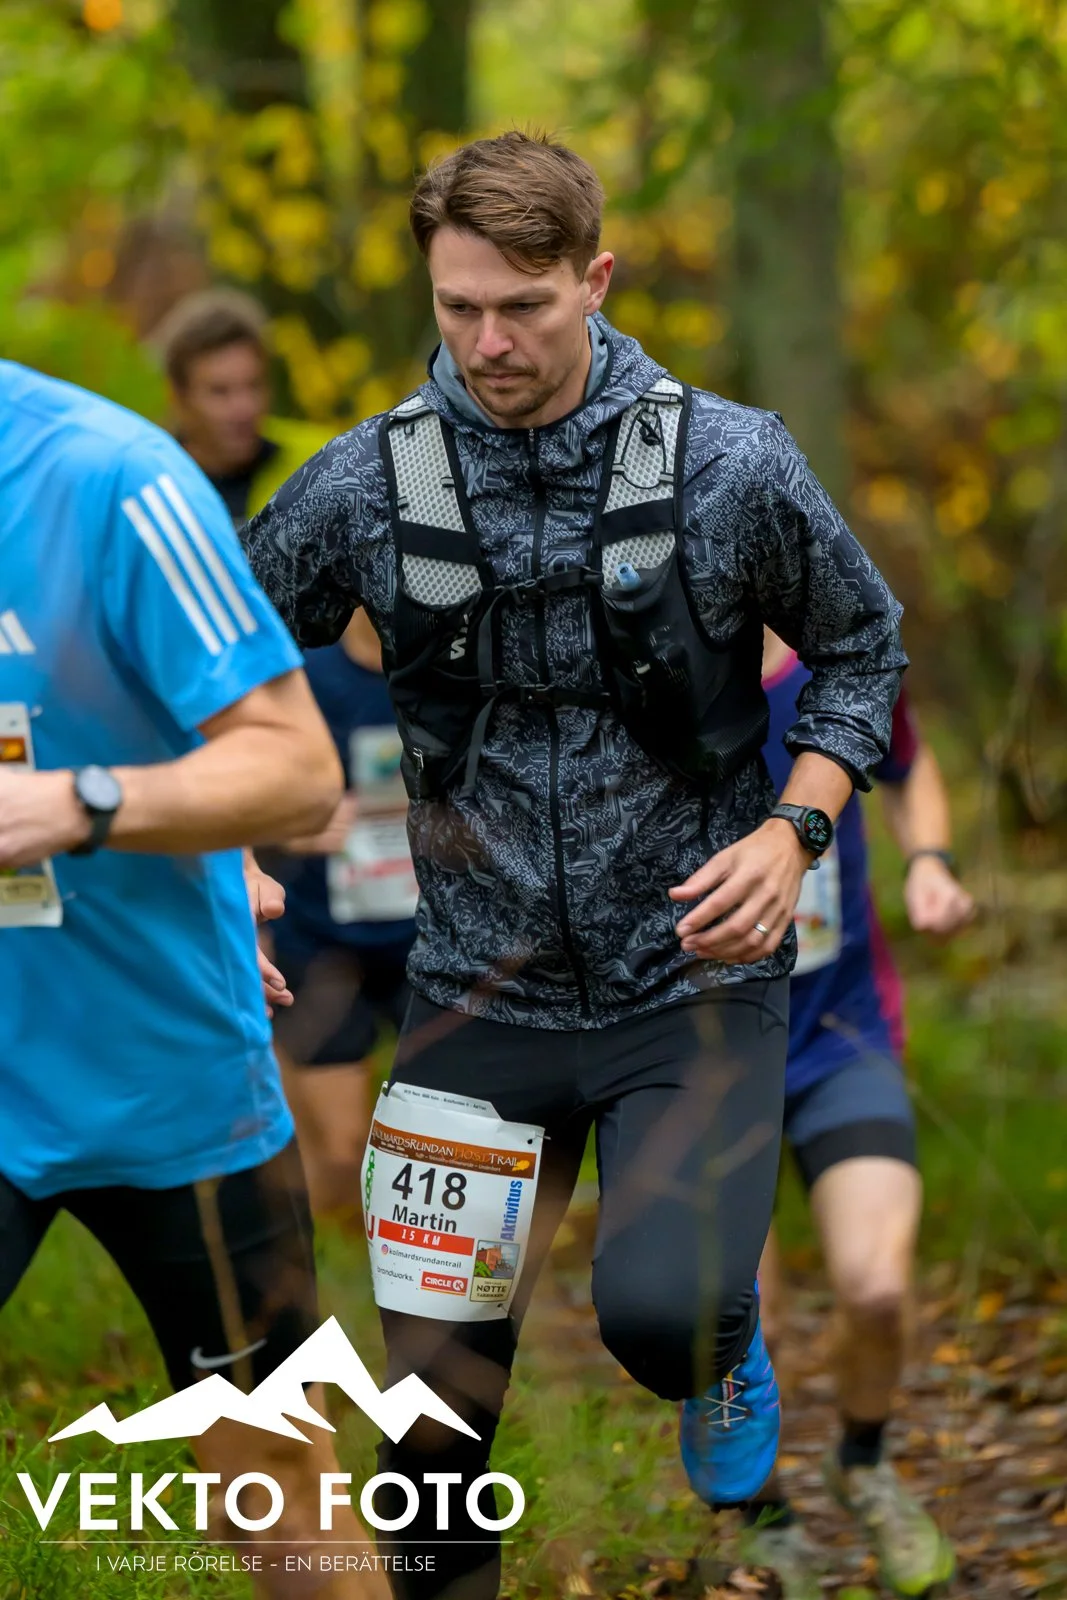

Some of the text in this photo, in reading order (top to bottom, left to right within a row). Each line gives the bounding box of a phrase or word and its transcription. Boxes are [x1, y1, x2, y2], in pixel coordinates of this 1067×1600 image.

[391, 1162, 467, 1210] 418
[392, 1203, 457, 1233] Martin
[500, 1180, 523, 1241] Aktivitus
[401, 1229, 441, 1246] 15 KM
[389, 1247, 462, 1268] kolmardsrundantrail
[424, 1276, 464, 1291] CIRCLE K
